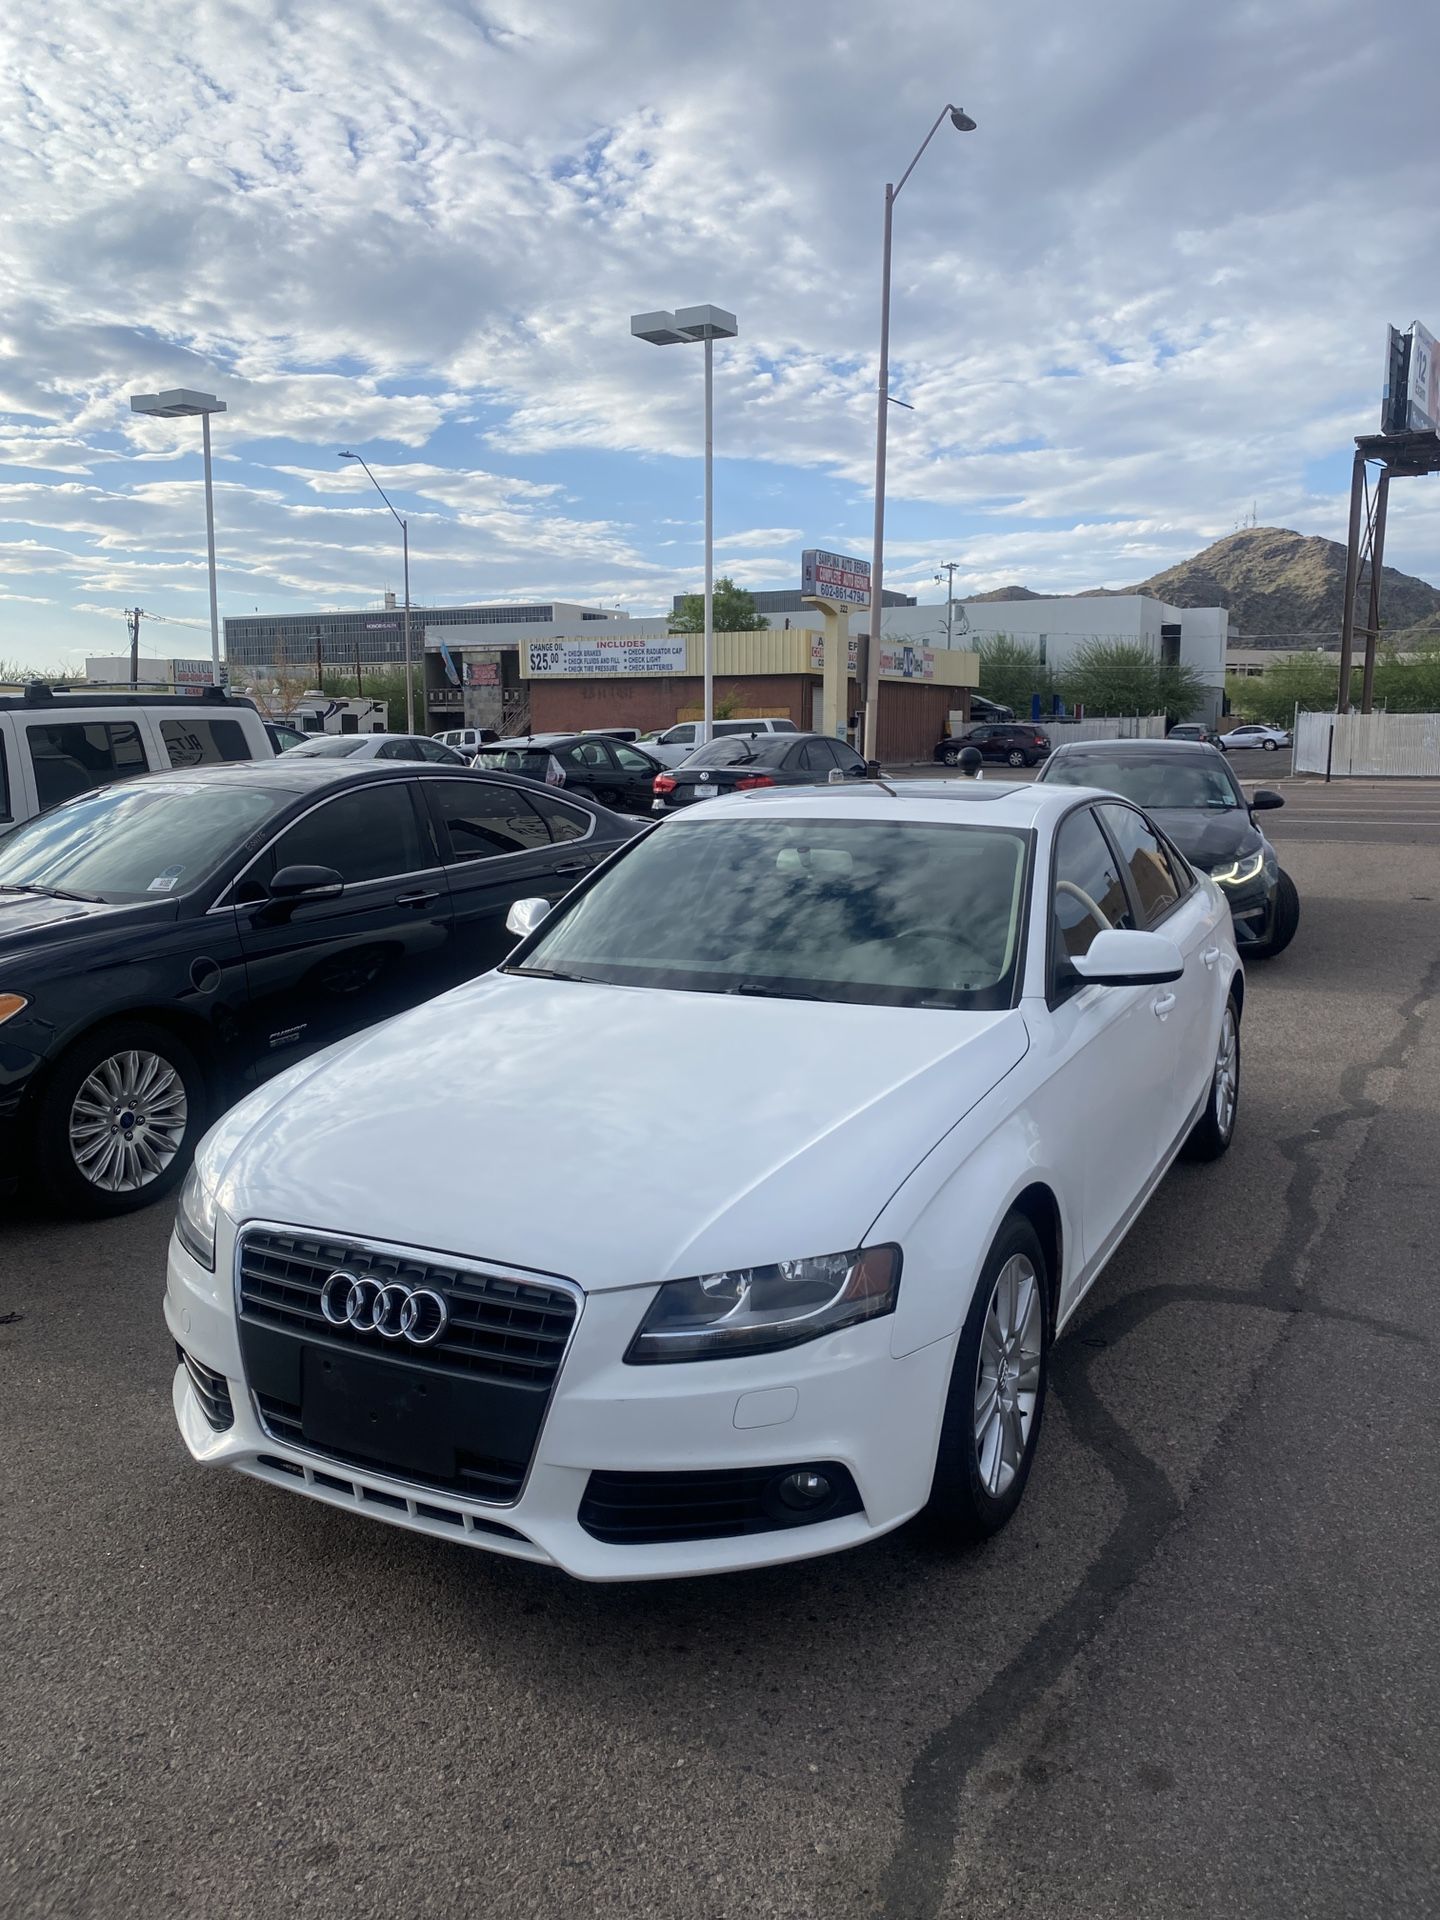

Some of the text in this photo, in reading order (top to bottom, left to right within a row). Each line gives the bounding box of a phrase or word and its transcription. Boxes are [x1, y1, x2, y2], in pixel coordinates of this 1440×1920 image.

[530, 643, 564, 652] CHANGE OIL
[596, 640, 646, 649] INCLUDES
[628, 648, 645, 656] CHECK
[672, 647, 683, 655] CAP
[584, 657, 600, 665] FLUIDS
[628, 656, 645, 664] CHECK
[568, 665, 583, 673] CHECK
